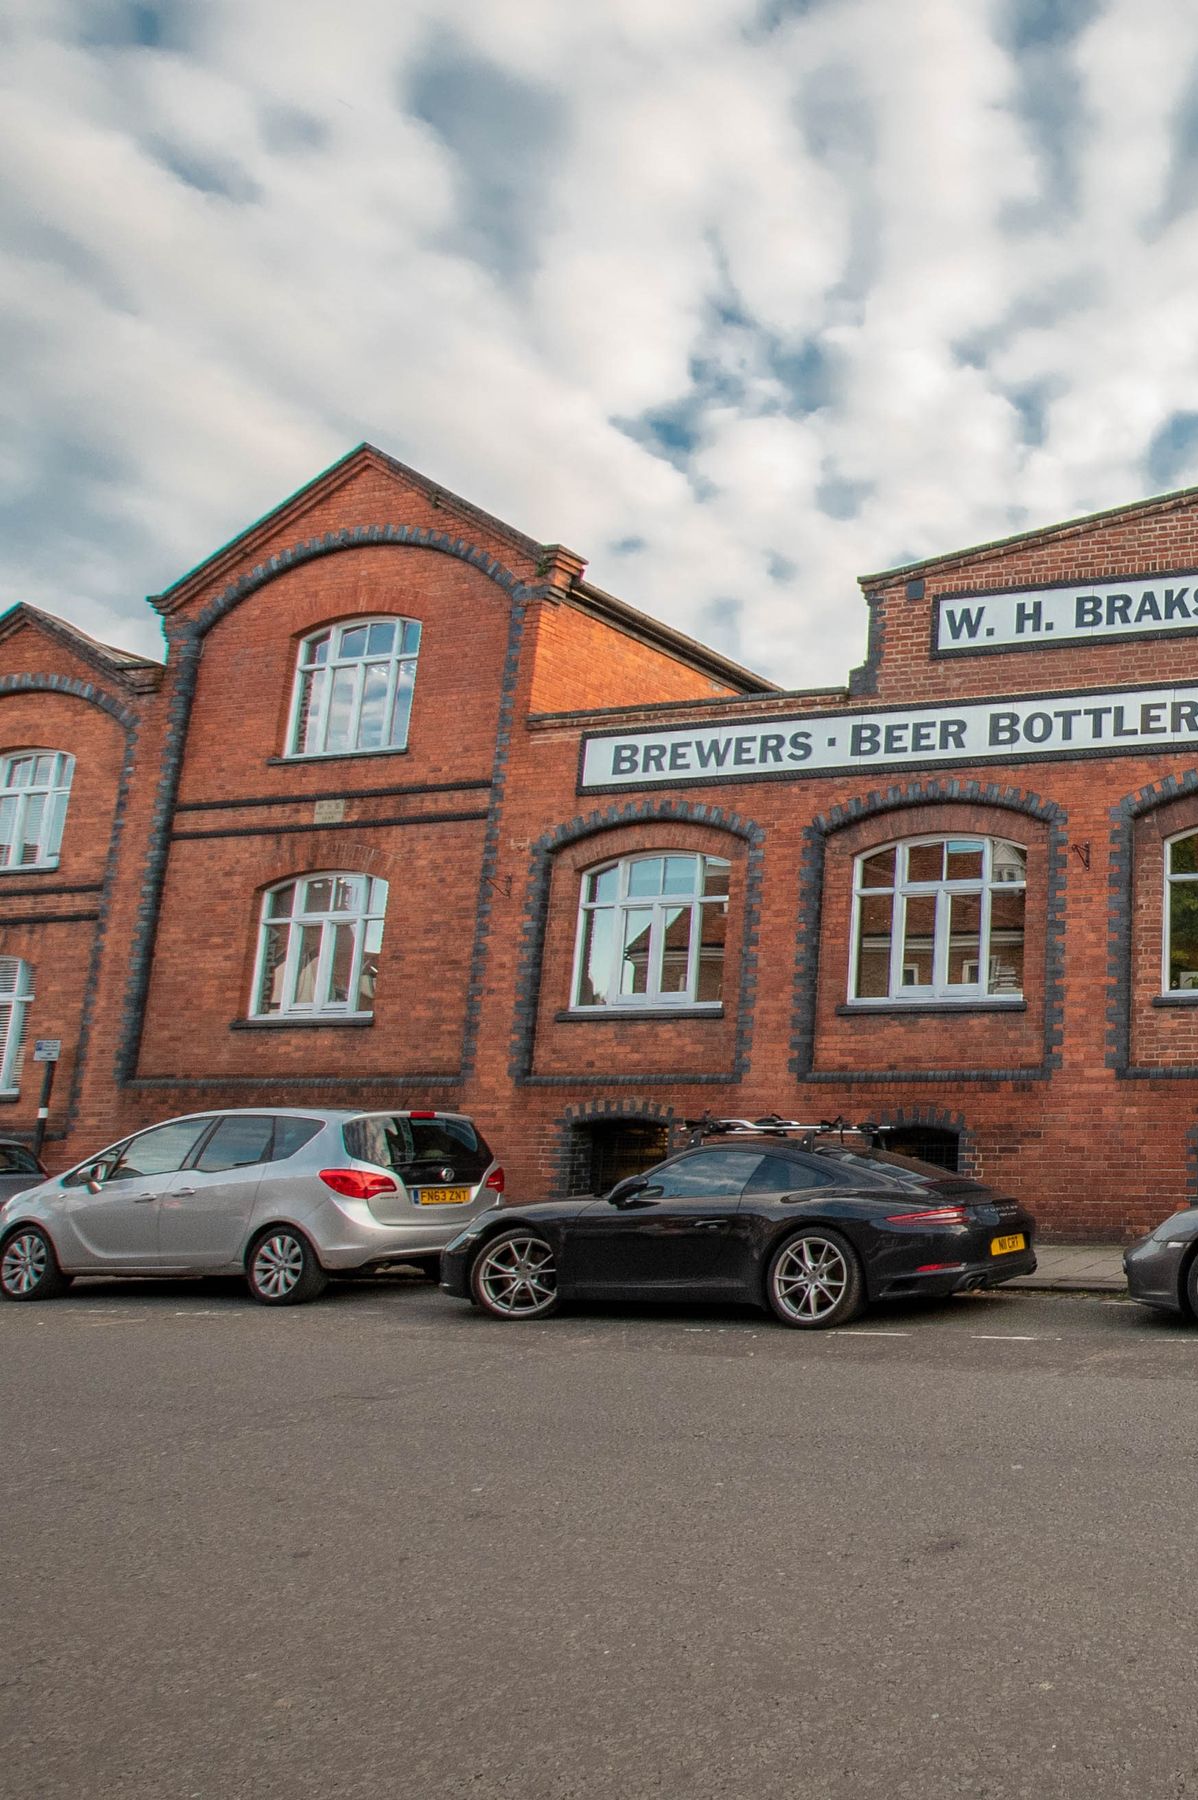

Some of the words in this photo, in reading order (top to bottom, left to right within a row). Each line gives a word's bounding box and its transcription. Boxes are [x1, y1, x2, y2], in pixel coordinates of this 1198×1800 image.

[945, 605, 995, 640] W.
[1015, 600, 1054, 634] H.
[611, 731, 813, 776] BREWERS
[850, 719, 968, 757] BEER
